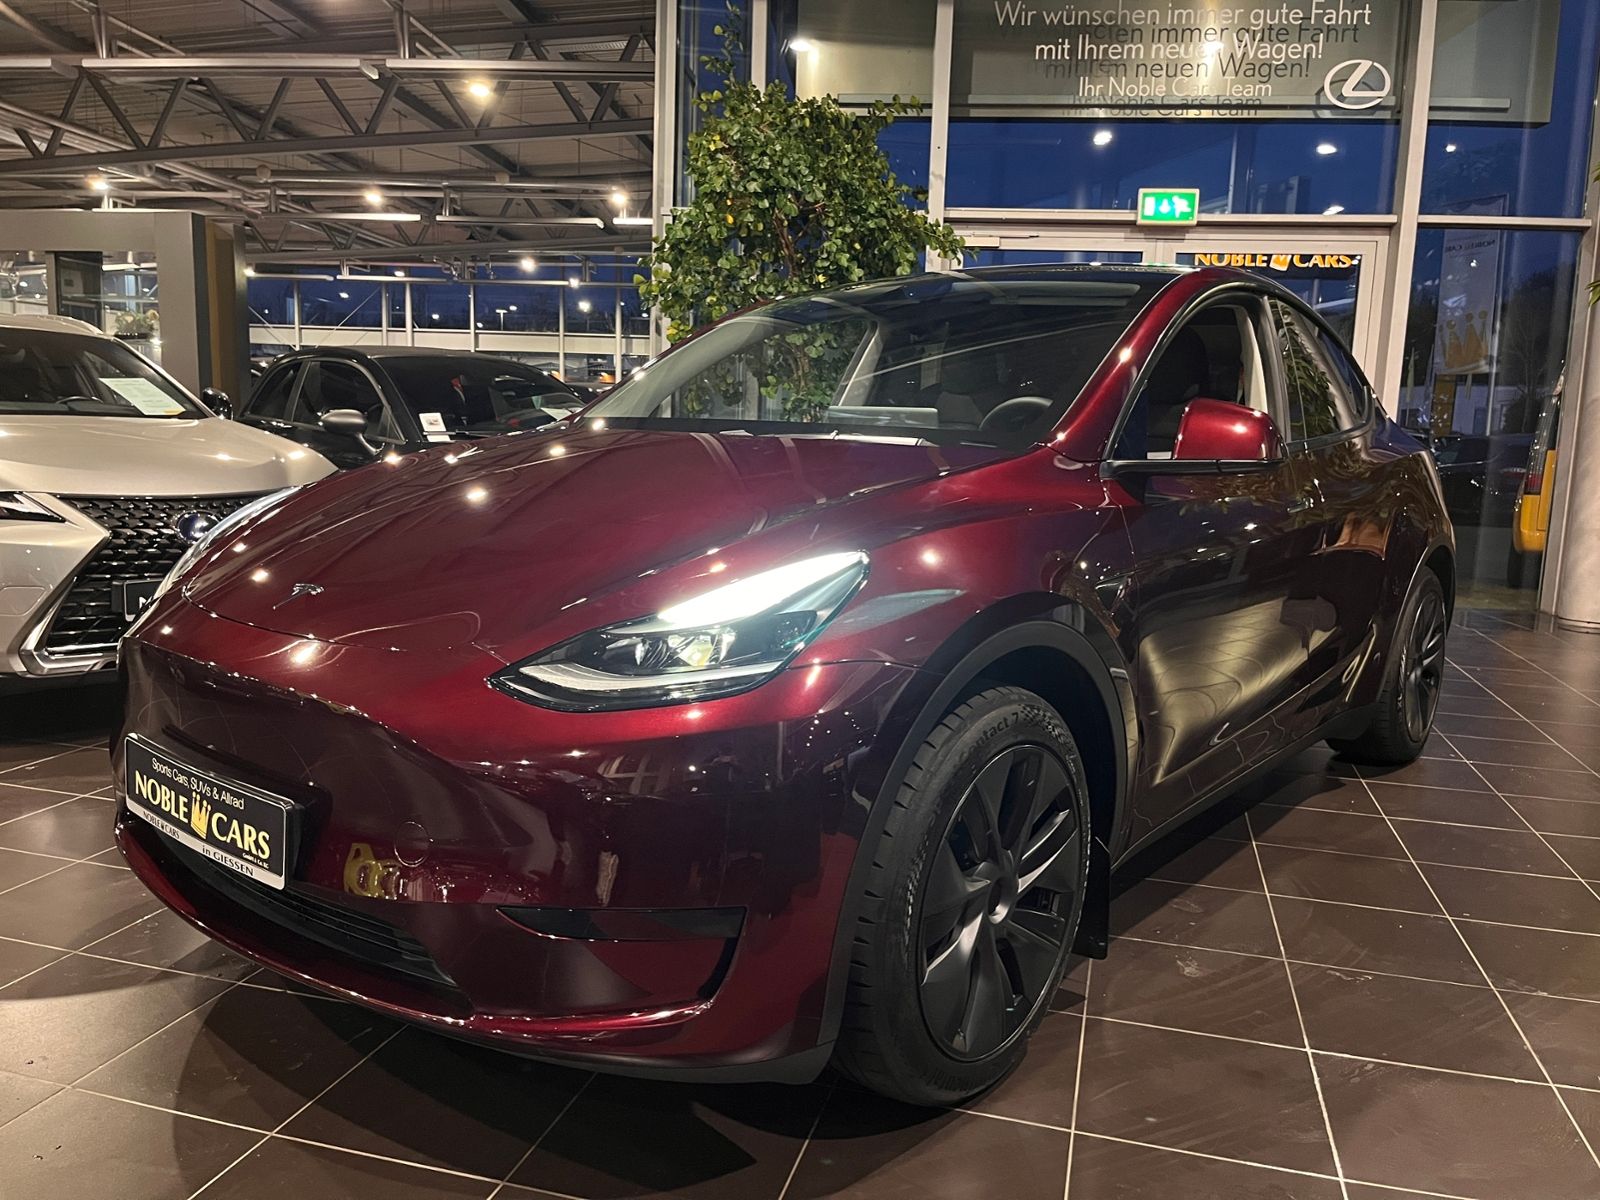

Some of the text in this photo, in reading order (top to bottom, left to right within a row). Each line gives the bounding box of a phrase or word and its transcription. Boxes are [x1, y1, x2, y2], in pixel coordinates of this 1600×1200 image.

[995, 0, 1372, 30] Wir wünschen immer gute Fahrt
[1035, 38, 1070, 61] mit
[1077, 34, 1144, 60] Ihrem
[1233, 32, 1323, 64] Wagen!
[1079, 76, 1272, 97] Ihr Noble Car Team
[1194, 253, 1352, 268] NOBLE CARS
[152, 757, 245, 810] Sports Cars, SUVs & Allrad
[135, 770, 270, 860] NOBLE CARS
[143, 811, 180, 839] NOBLE CARS
[202, 845, 211, 855] in
[213, 851, 254, 876] GIESSEN
